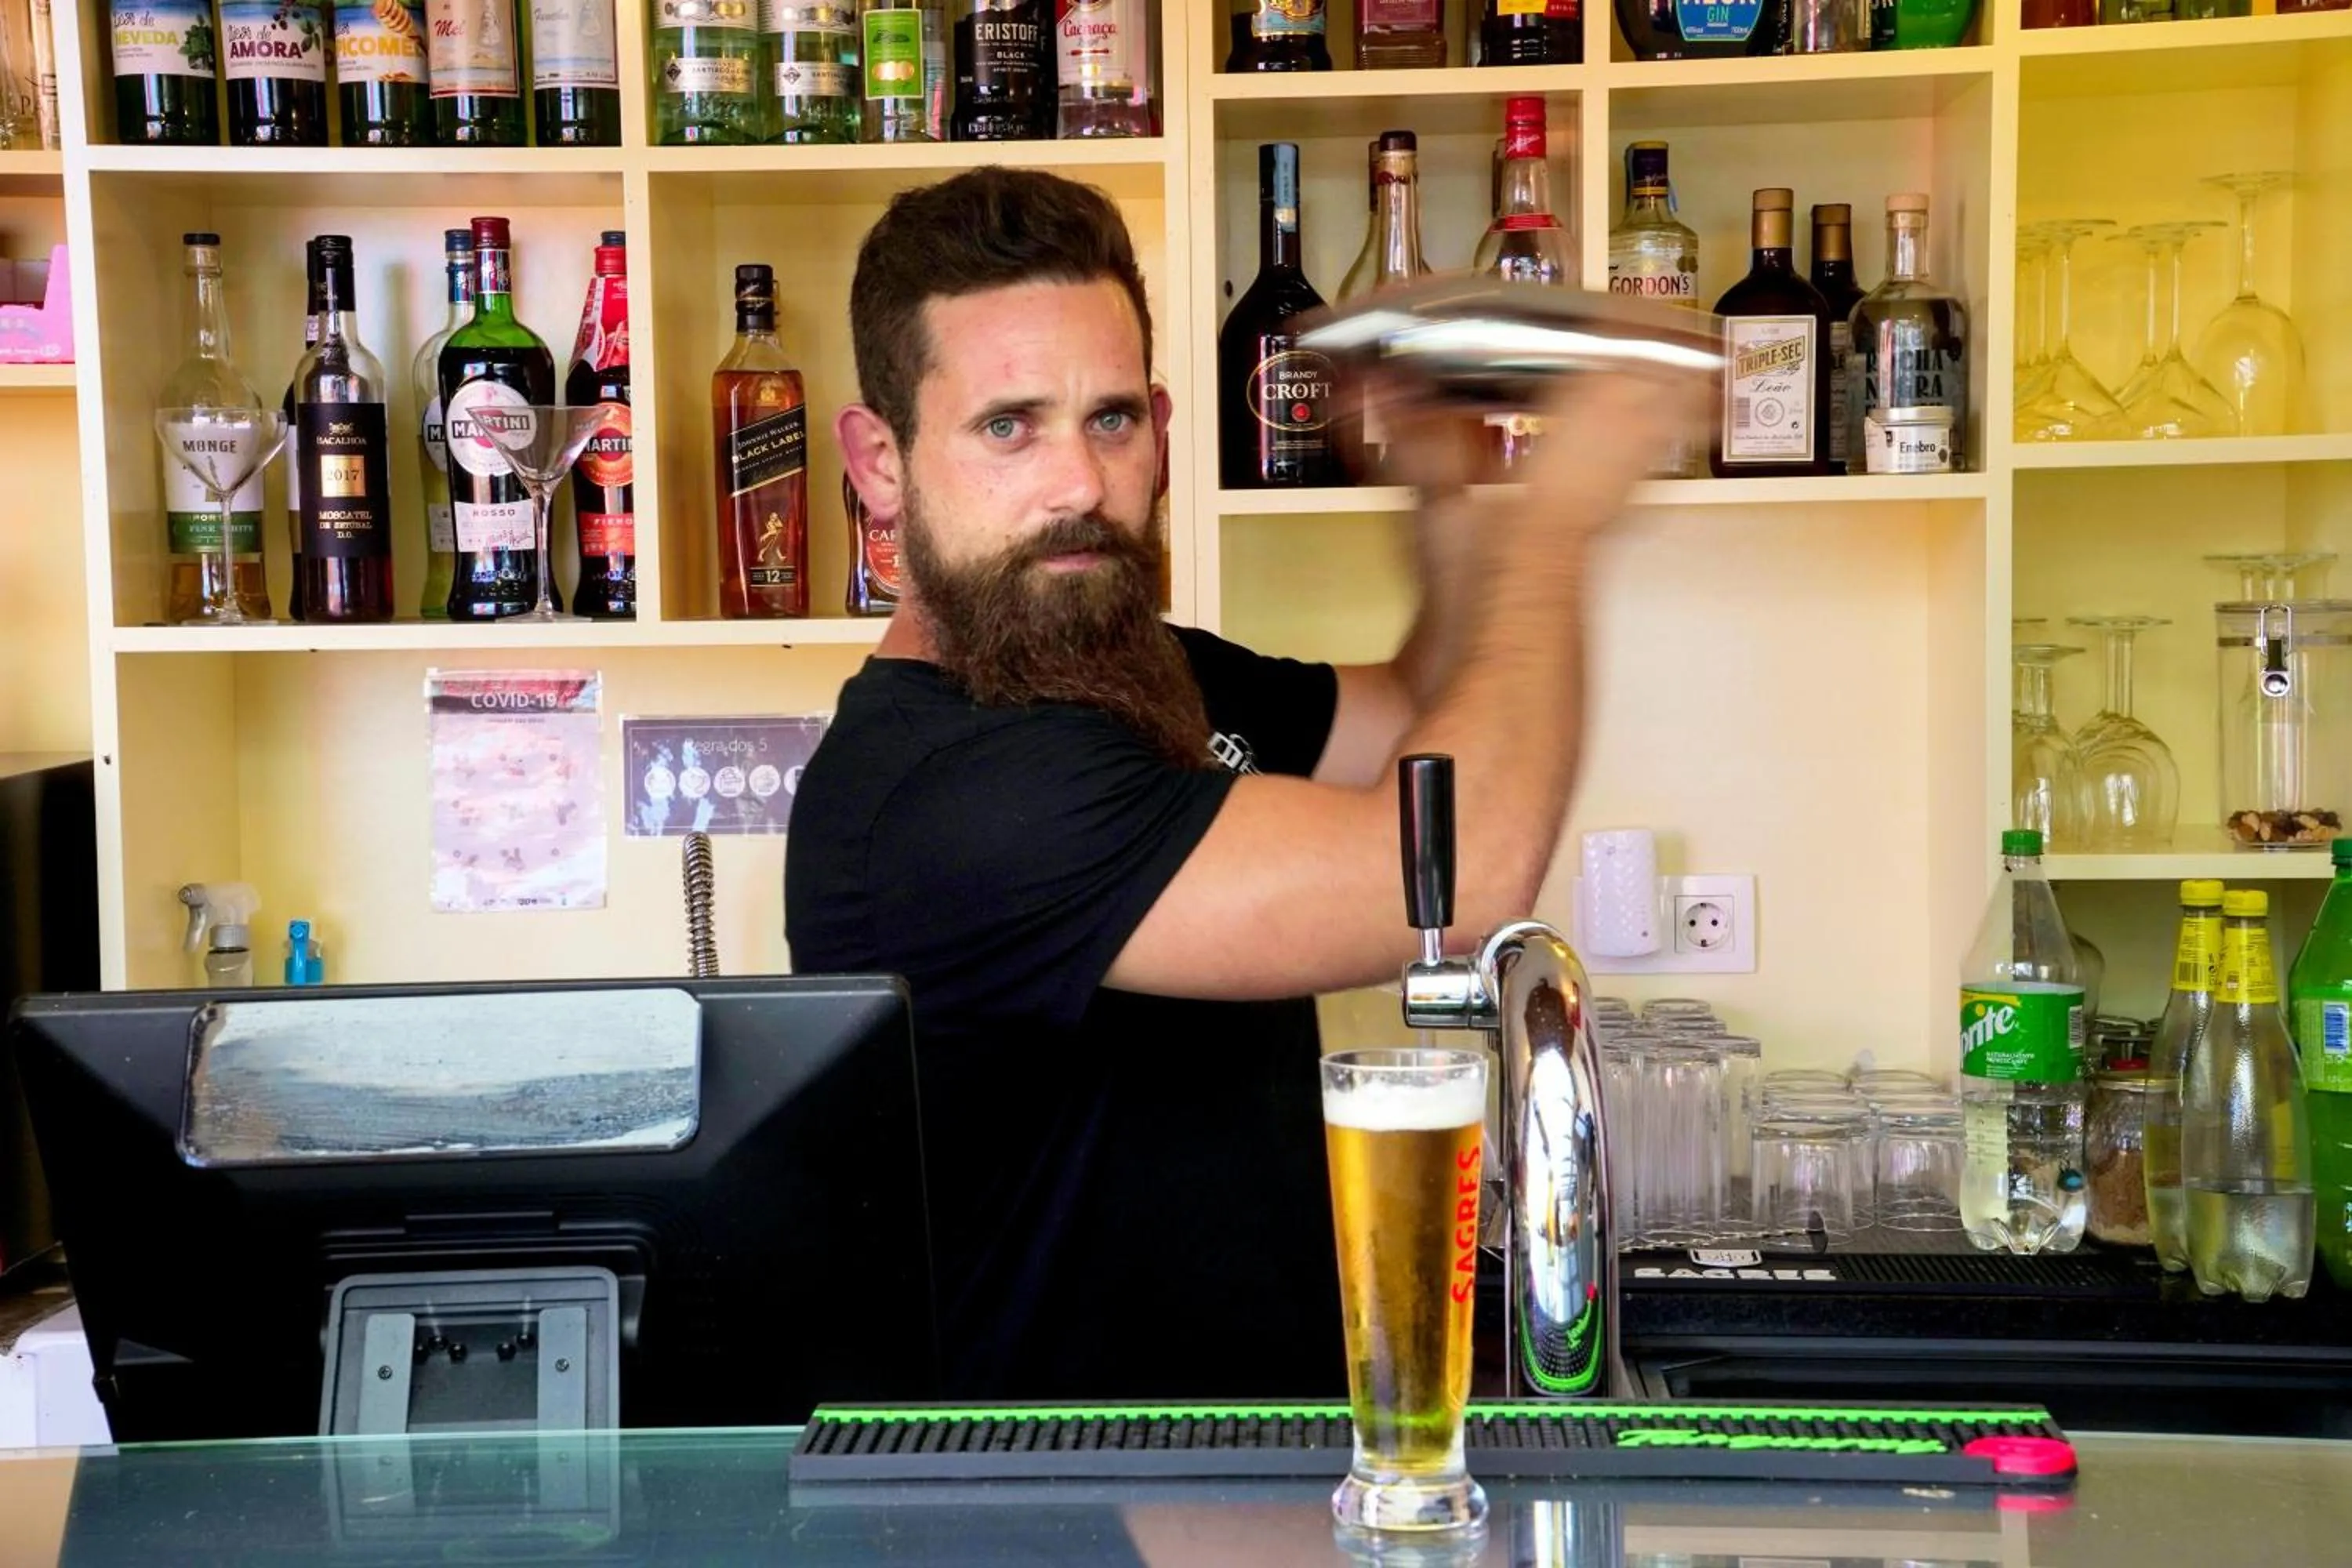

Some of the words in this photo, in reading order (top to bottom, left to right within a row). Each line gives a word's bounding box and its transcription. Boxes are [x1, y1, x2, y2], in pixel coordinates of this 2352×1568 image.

[1707, 6, 1729, 22] GIN
[975, 23, 1038, 42] ERISTOFF
[230, 41, 303, 59] AMORA
[1609, 274, 1690, 296] GORDON'S
[1738, 341, 1803, 374] TRIPLE-SEC
[1279, 371, 1317, 380] BRANDY
[1262, 382, 1331, 400] CROFT
[183, 441, 238, 453] MONGE
[326, 469, 360, 481] 2017
[765, 570, 782, 583] 12
[472, 694, 557, 709] COVID-19
[1451, 1145, 1481, 1304] SAGRES
